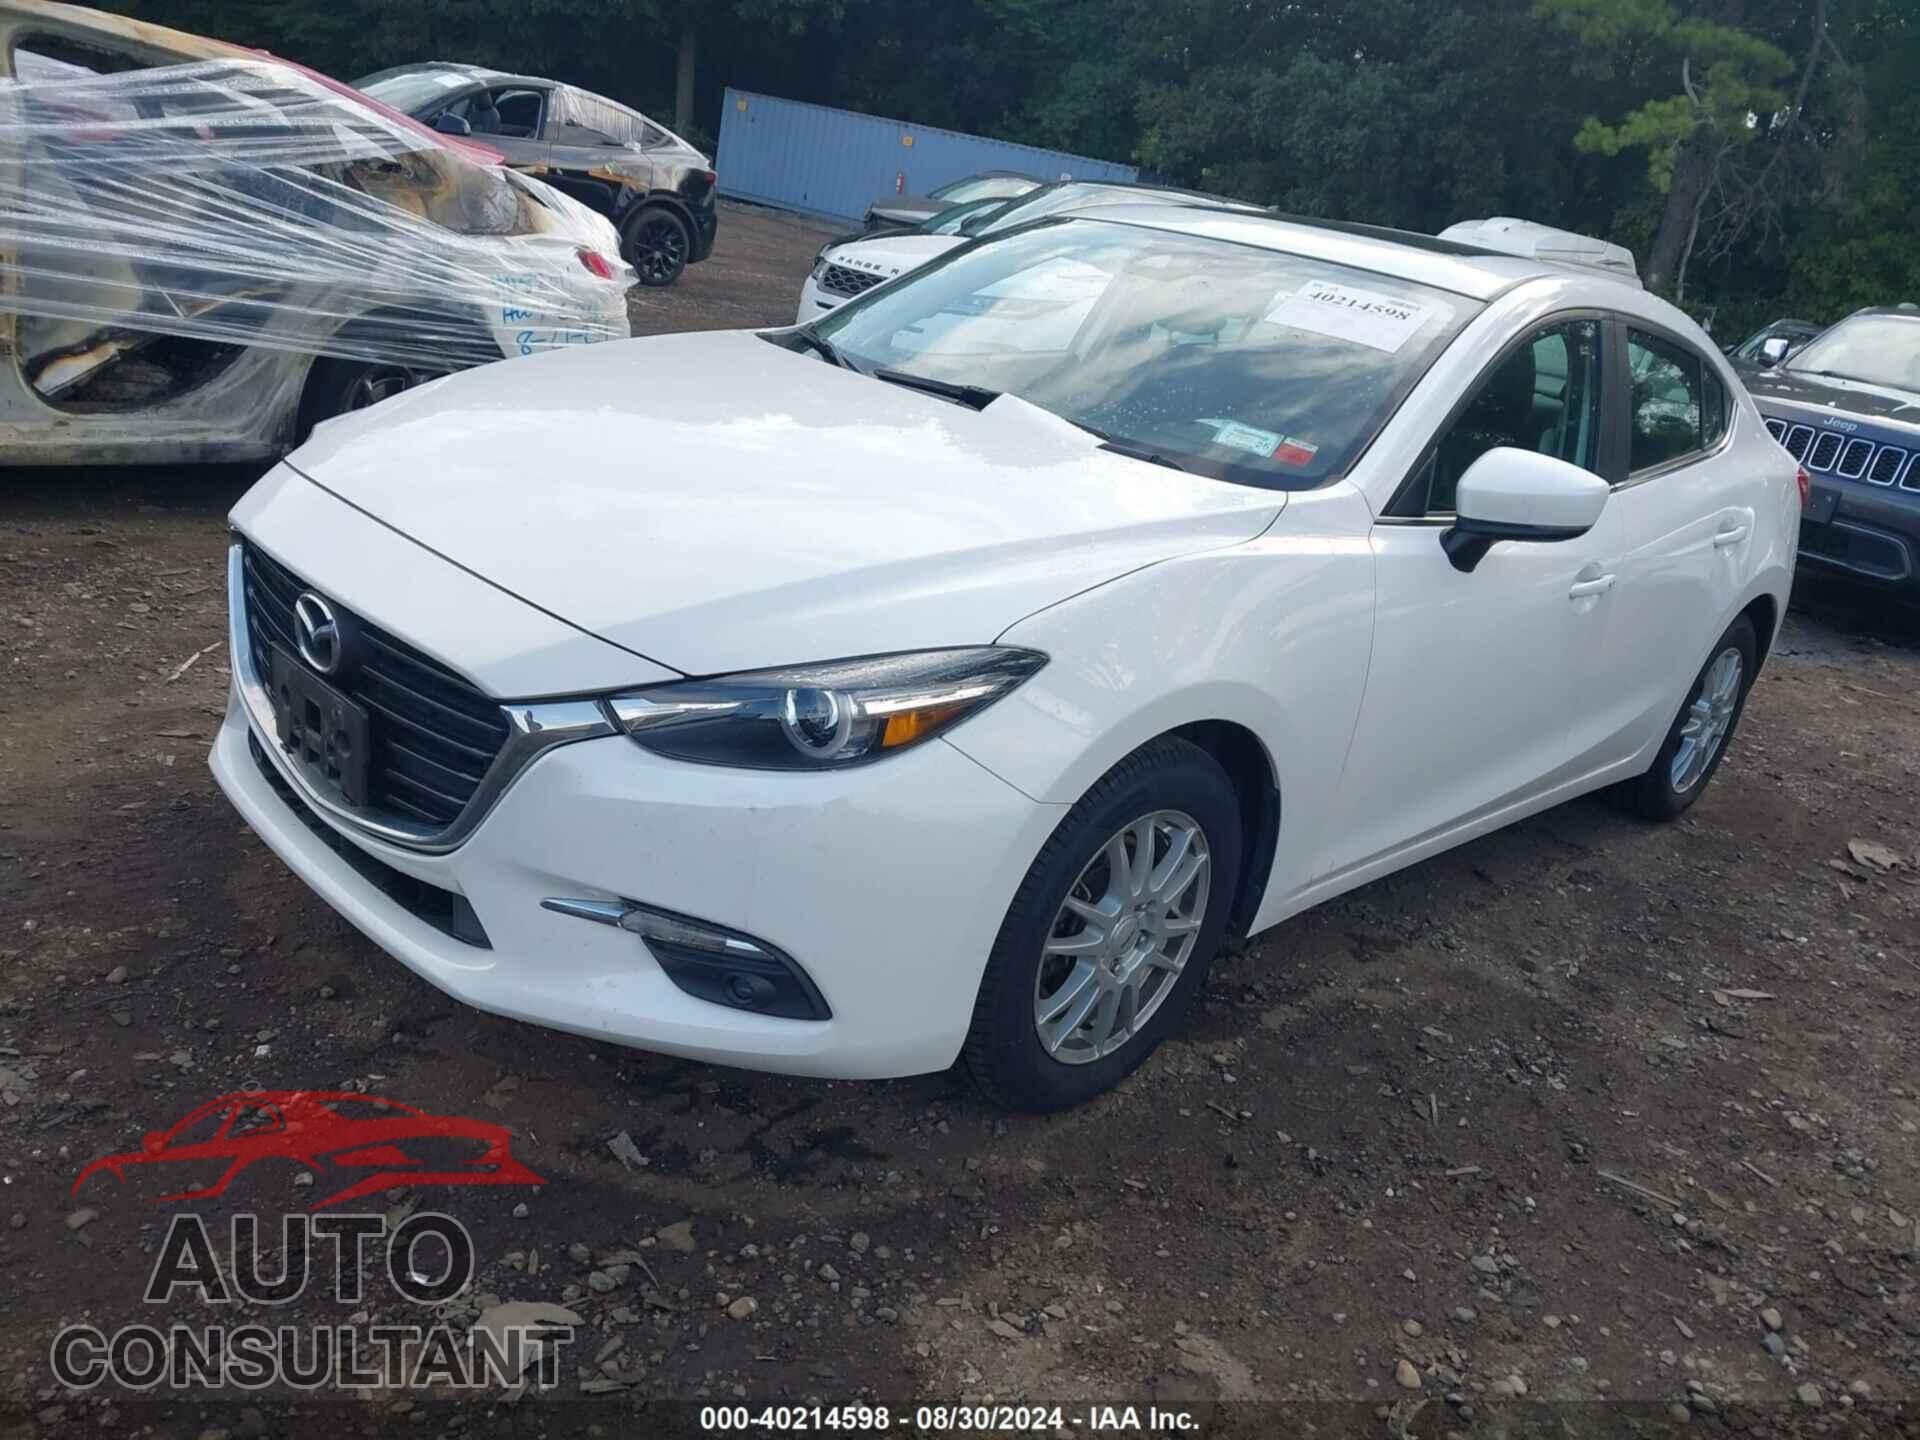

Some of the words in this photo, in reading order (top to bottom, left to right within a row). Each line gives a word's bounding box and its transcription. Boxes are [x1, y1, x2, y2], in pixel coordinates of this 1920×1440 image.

[838, 256, 882, 271] RANGE
[1309, 290, 1412, 320] 40214598
[1823, 416, 1858, 432] Jeep
